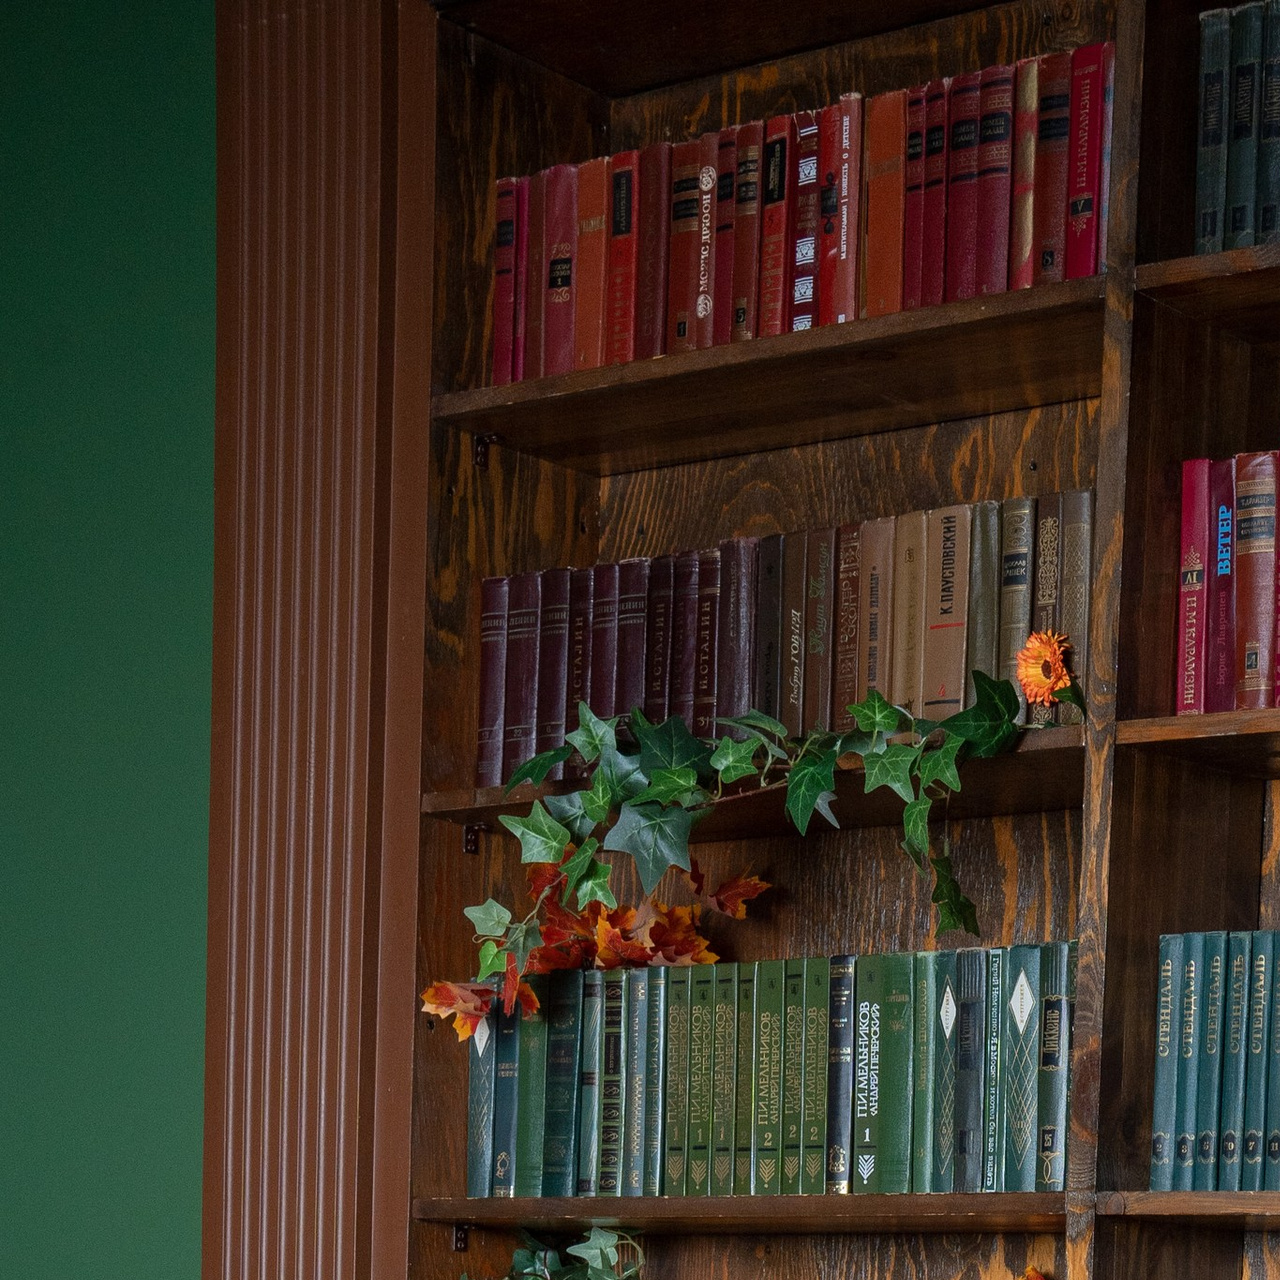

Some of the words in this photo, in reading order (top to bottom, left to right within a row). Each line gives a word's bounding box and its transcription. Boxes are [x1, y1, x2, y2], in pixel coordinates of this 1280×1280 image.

[701, 193, 712, 244] ДРЮОН
[940, 515, 957, 616] К.ПАУСТОВСКИЙ
[1216, 504, 1233, 577] ВЕТЕР
[699, 602, 711, 690] И.СТАЛИН
[1183, 596, 1201, 703] Н.М.КАРАМЗИН
[1043, 1009, 1059, 1054] Диккенс
[1158, 958, 1172, 1058] СТЕНДАЛЬ
[1182, 959, 1197, 1059] СТЕНДАЛЬ
[1206, 955, 1222, 1054] СТЕНДАЛЬ
[1229, 954, 1244, 1054] СТЕНДАЛЬ
[1251, 954, 1266, 1054] СТЕНДАЛЬ
